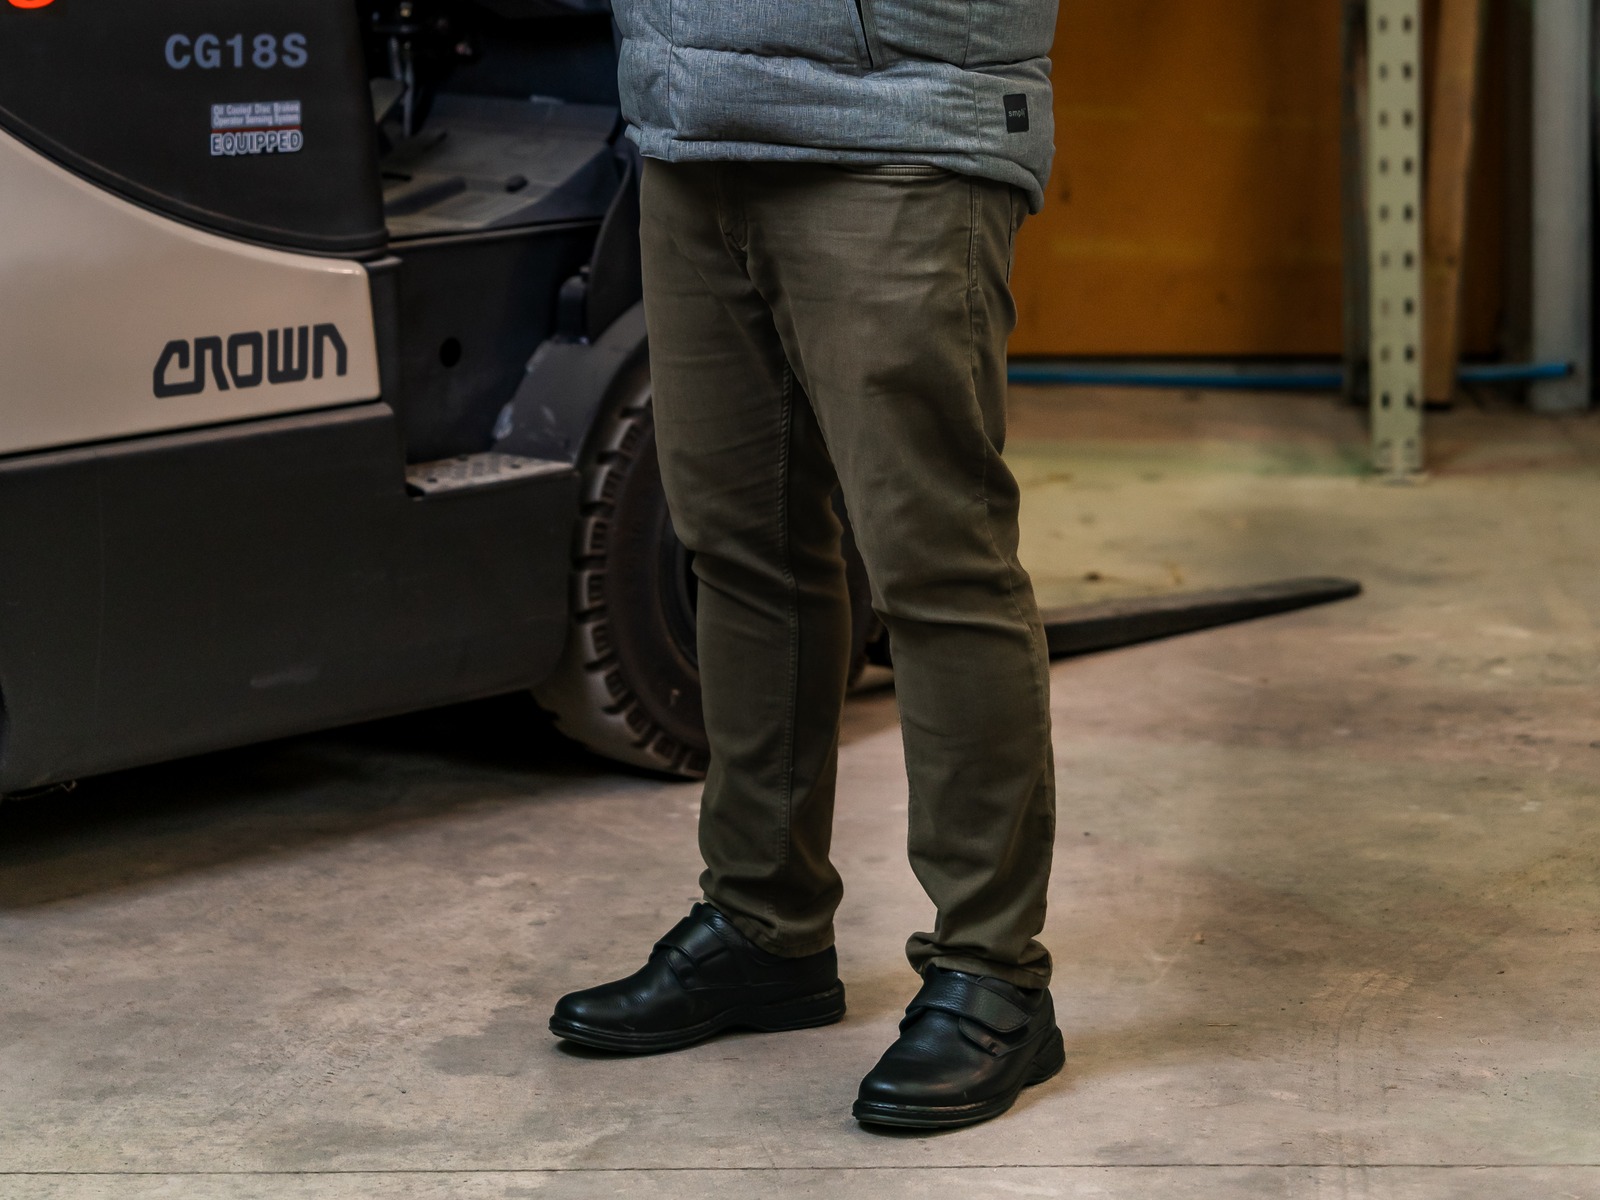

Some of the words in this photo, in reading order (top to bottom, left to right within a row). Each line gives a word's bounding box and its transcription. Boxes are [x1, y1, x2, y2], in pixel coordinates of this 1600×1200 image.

[165, 33, 308, 69] CG18S
[211, 131, 303, 156] EQUIPPED
[153, 323, 347, 398] CROWN
